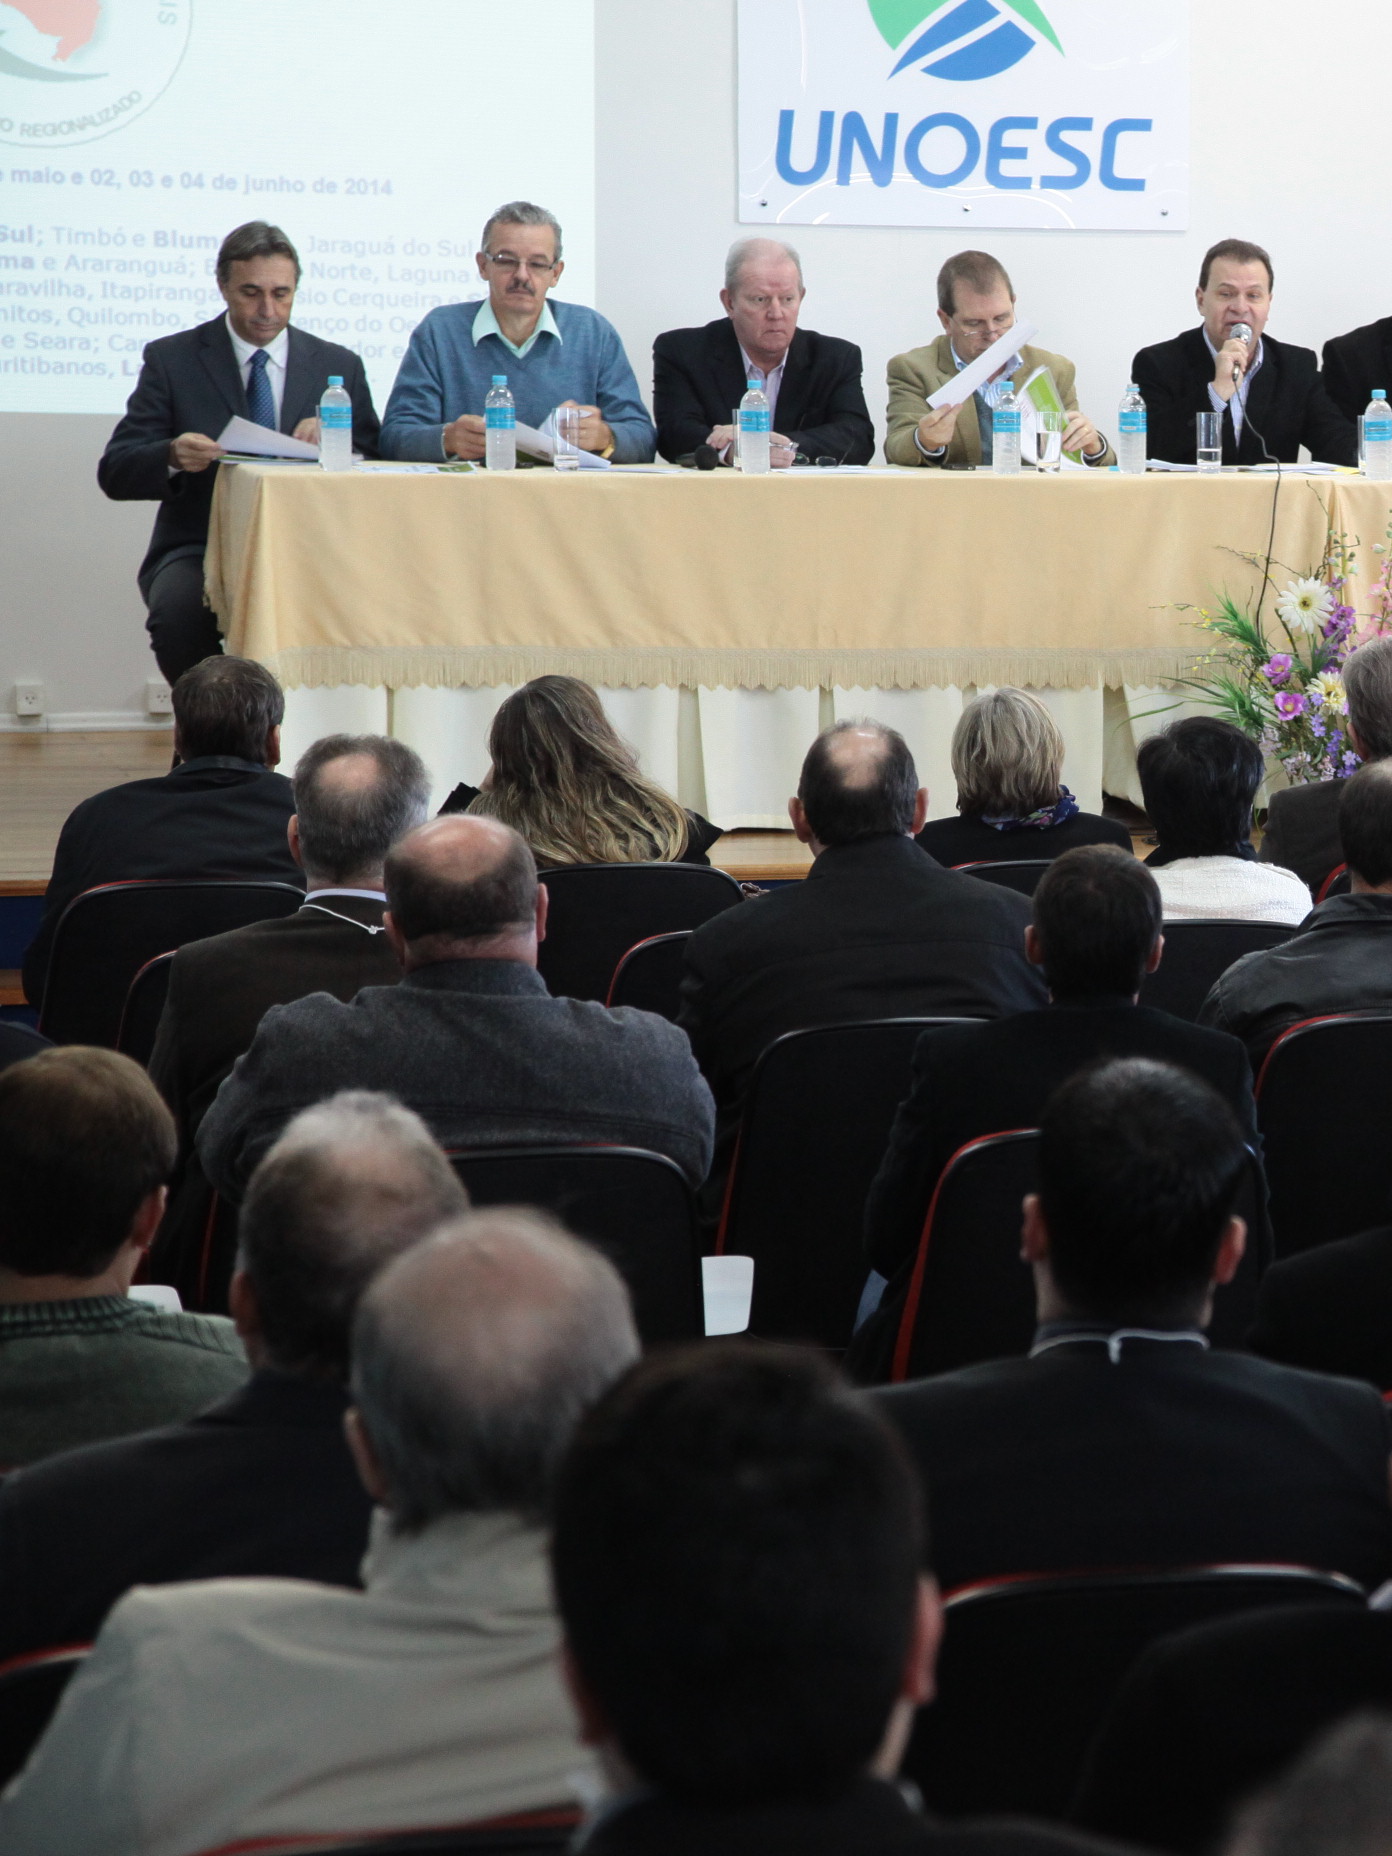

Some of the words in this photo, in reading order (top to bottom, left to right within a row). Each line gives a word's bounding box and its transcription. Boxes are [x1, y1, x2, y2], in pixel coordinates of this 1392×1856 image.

[20, 90, 142, 137] REGIONALIZADO
[774, 109, 1154, 192] UNOESC
[11, 167, 66, 184] maio
[71, 170, 83, 186] e
[90, 169, 122, 190] 02,
[129, 170, 154, 188] 03
[160, 173, 174, 189] e
[180, 172, 205, 189] 04
[212, 173, 237, 191] de
[243, 174, 306, 196] junho
[312, 176, 338, 194] de
[345, 177, 393, 196] 2014
[52, 225, 127, 247] Timbó
[132, 232, 146, 248] e
[306, 235, 395, 258] Jaraguá
[403, 237, 431, 256] do
[42, 256, 56, 272] e
[64, 253, 197, 278] Araranguá;
[310, 262, 380, 285] Norte,
[388, 264, 470, 286] Laguna
[0, 278, 94, 301] ravilha,
[333, 288, 442, 310] Cerqueira
[67, 305, 188, 330] Quilombo,
[355, 314, 383, 332] do
[24, 332, 100, 354] Seara;
[0, 355, 115, 379] ritibanos,
